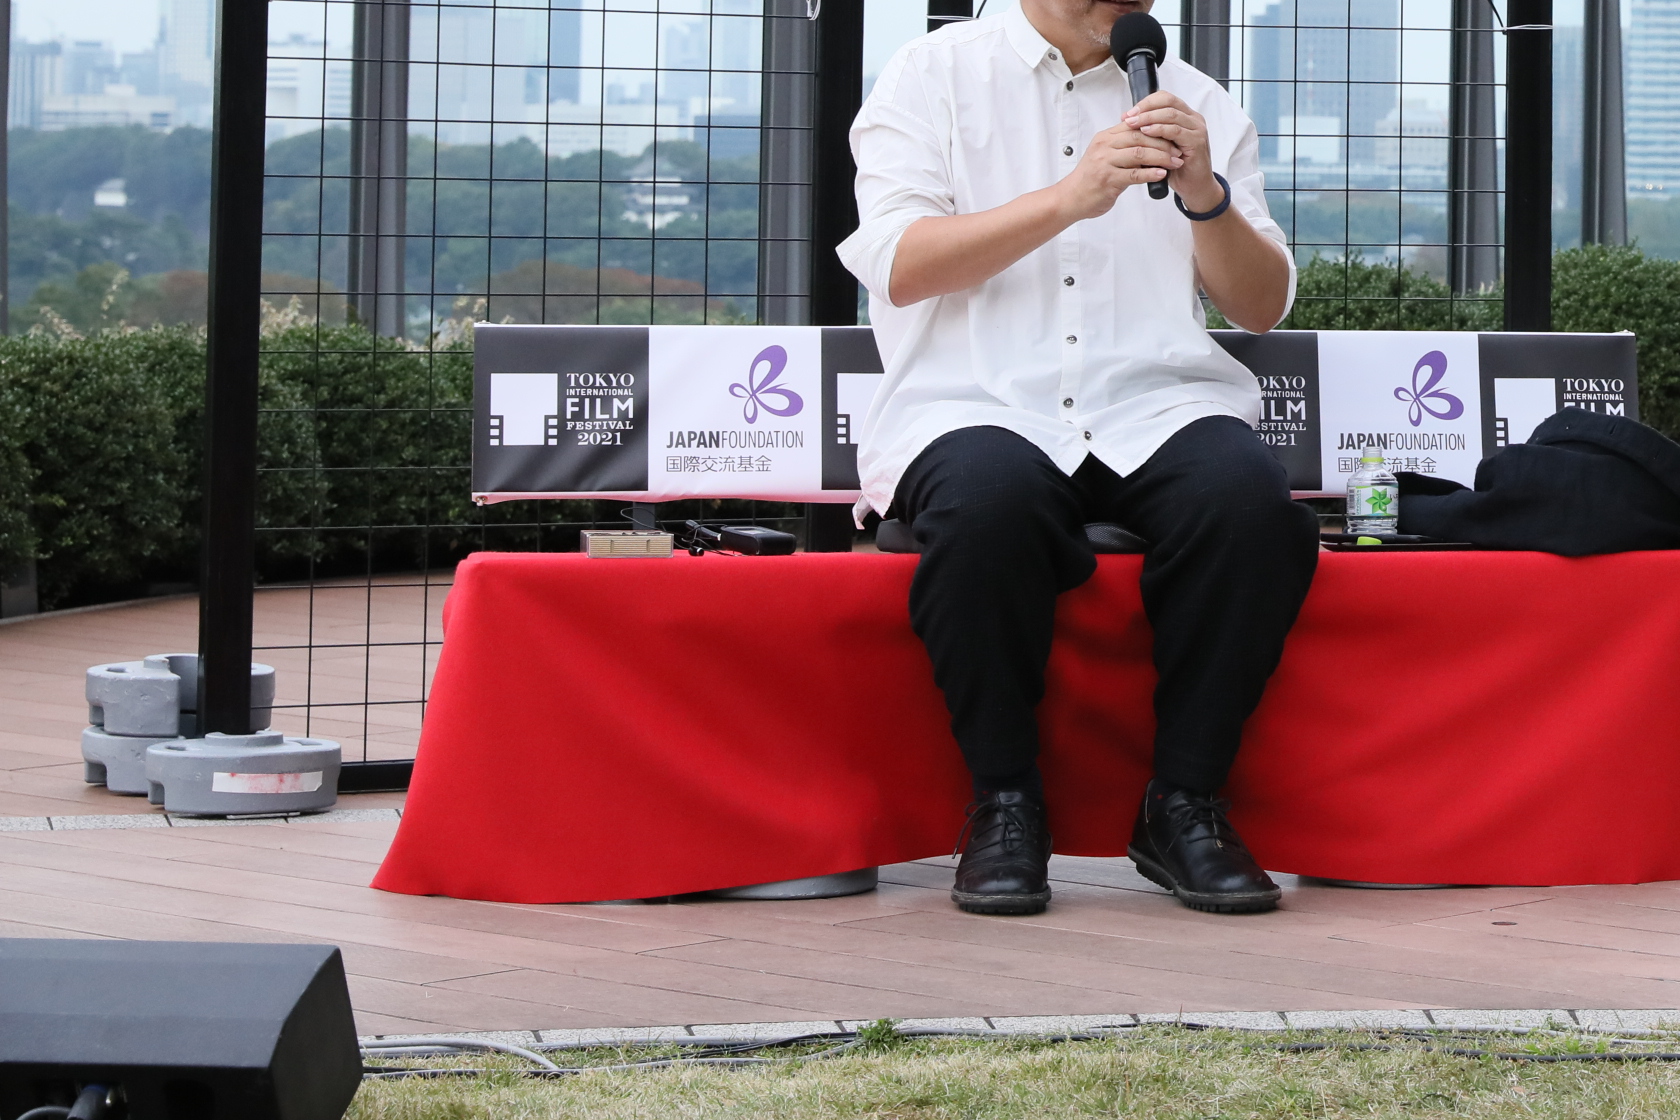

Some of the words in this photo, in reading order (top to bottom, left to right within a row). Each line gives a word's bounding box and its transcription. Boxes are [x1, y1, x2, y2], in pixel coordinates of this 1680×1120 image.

[566, 372, 635, 387] TOKYO
[1256, 375, 1306, 389] OKYO
[1562, 378, 1625, 393] TOKYO
[566, 388, 634, 396] INTERNATIONAL
[1563, 393, 1624, 401] INTERNATIONAL
[566, 397, 634, 419] FILM
[1260, 400, 1306, 421] ILM
[566, 421, 634, 430] FESTIVAL
[577, 431, 624, 446] 2021
[666, 455, 772, 473] 国際交流基金
